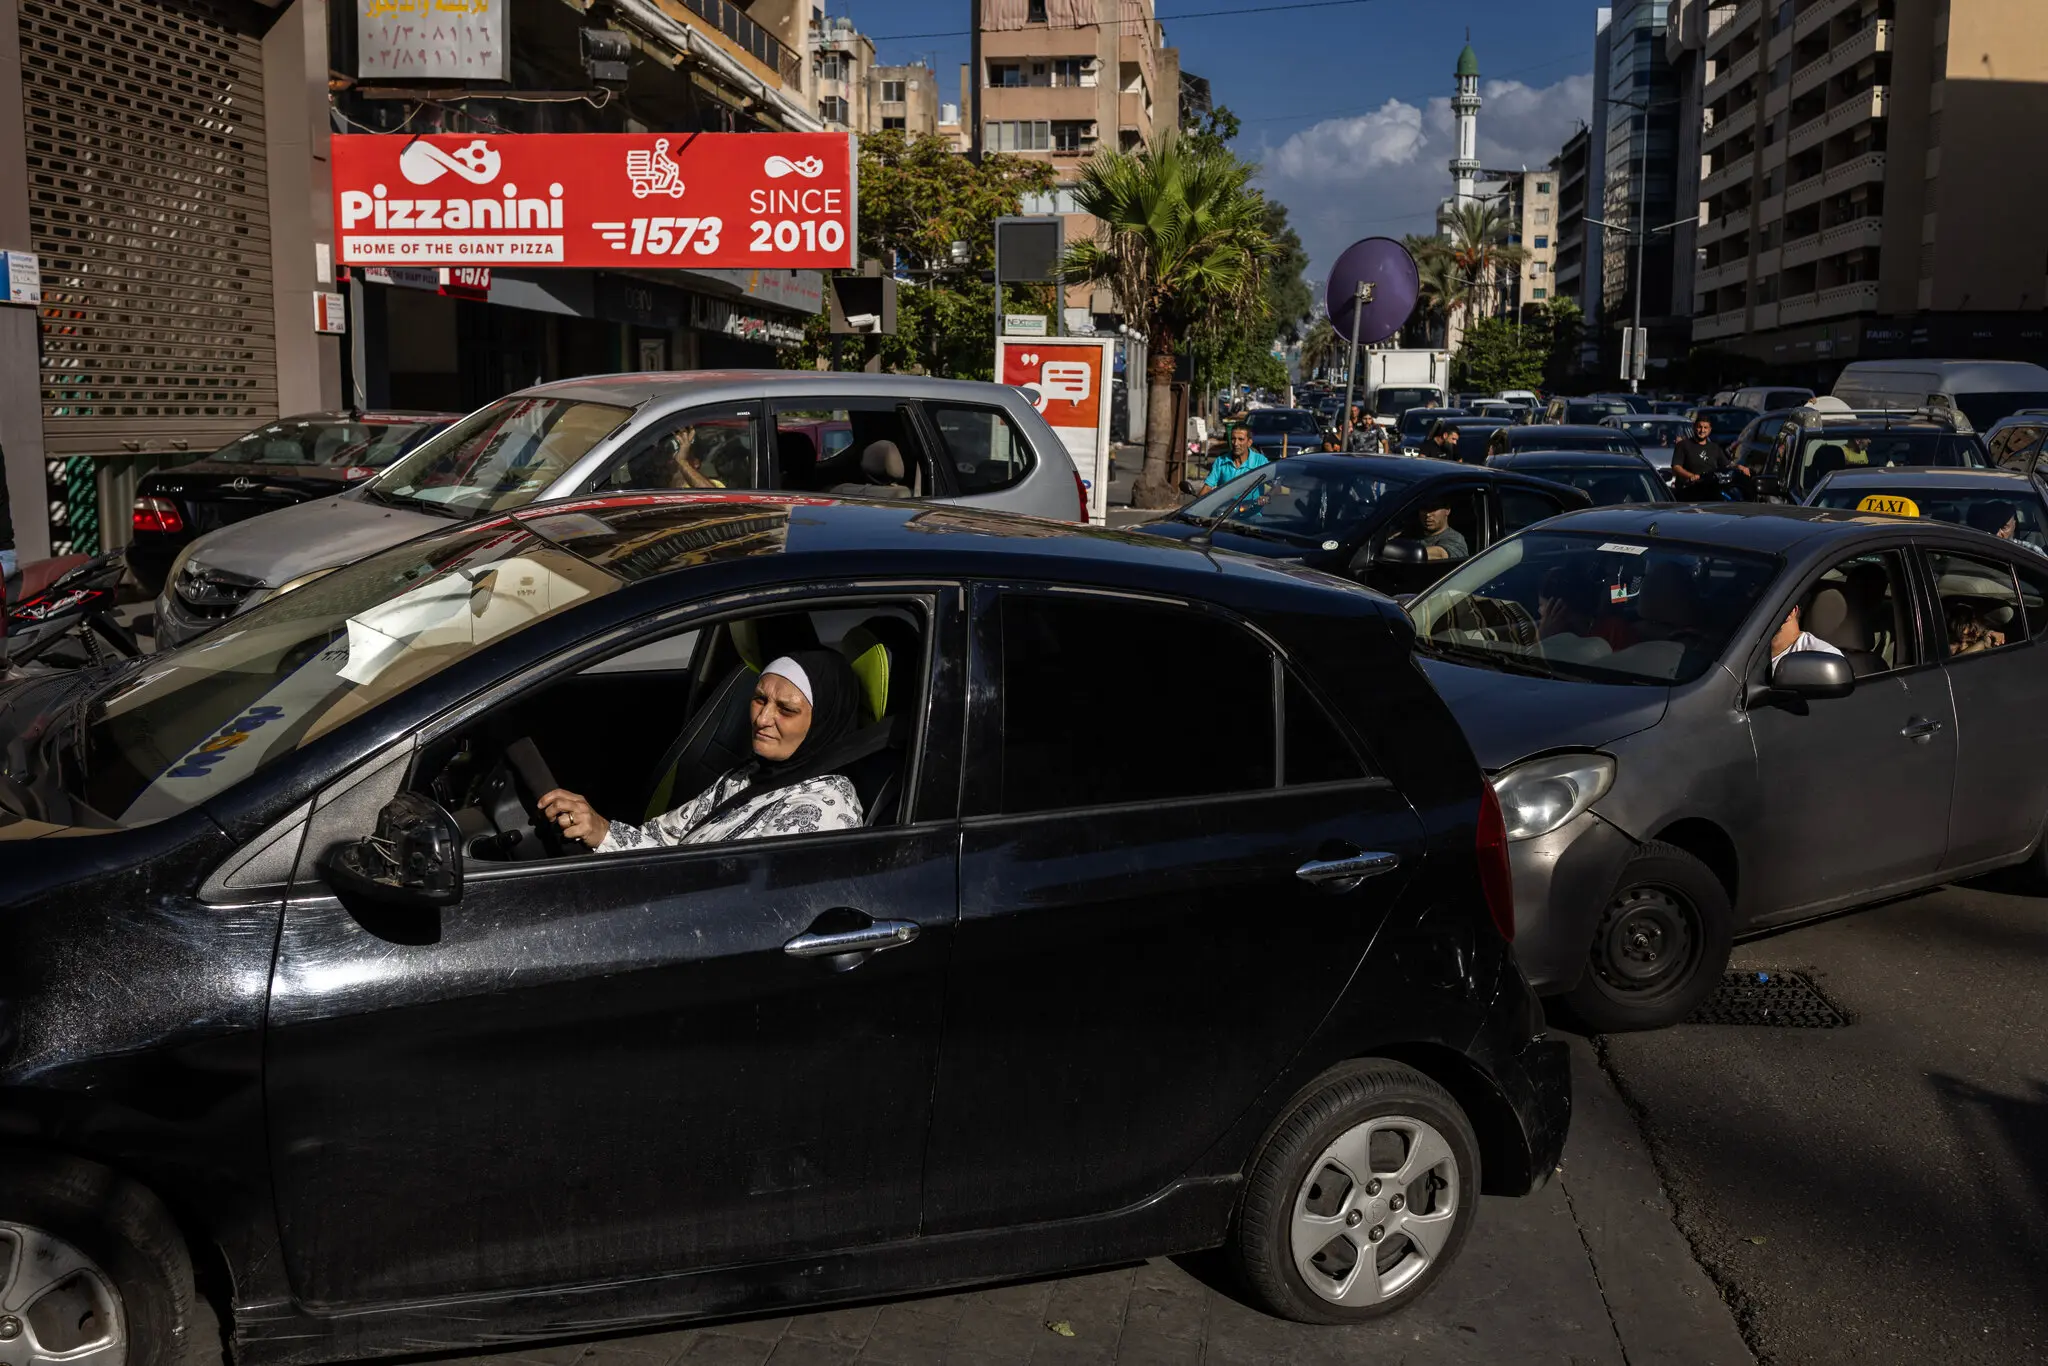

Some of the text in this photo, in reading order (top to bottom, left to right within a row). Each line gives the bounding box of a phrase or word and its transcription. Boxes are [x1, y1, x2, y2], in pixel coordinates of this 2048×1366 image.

[341, 183, 563, 229] Pizzanini
[750, 189, 842, 214] SINCE
[353, 243, 554, 254] HOME OF THE GIANT PIZZA
[630, 216, 723, 255] 1573
[750, 220, 845, 252] 2010
[1866, 498, 1905, 513] TAXI
